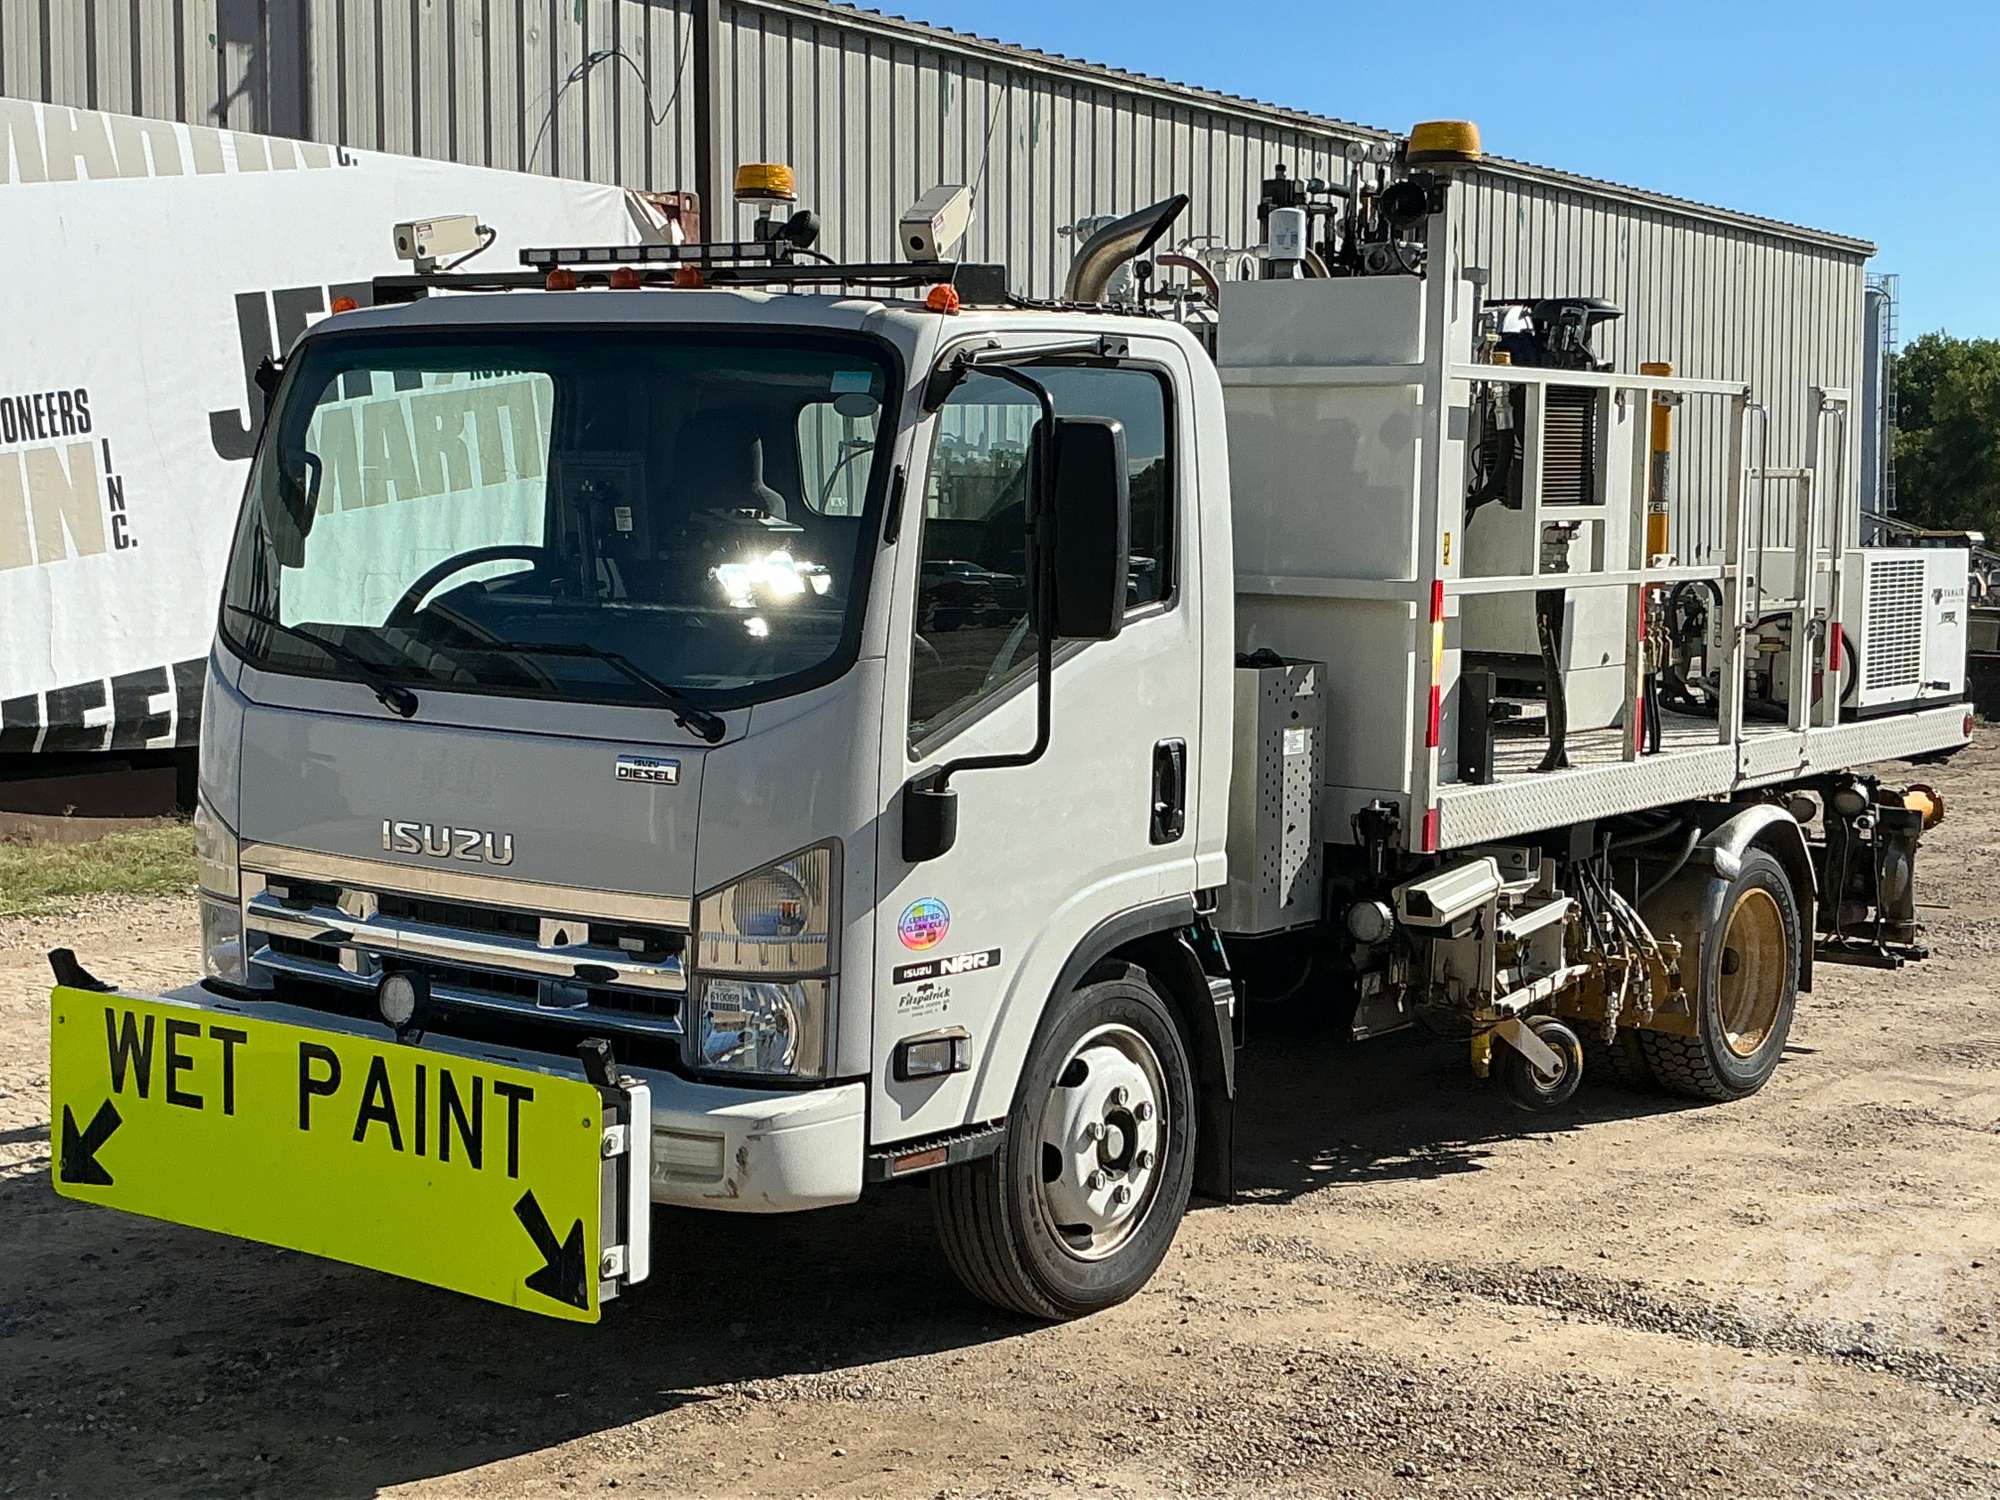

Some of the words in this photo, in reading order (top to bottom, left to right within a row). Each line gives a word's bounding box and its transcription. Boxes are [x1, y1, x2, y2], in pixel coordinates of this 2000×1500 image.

[0, 388, 92, 445] ONEERS
[618, 767, 674, 782] DIESEL
[382, 818, 514, 866] ISUZU
[903, 965, 932, 979] ISUZU
[940, 952, 990, 975] NRR
[104, 1007, 248, 1116] WET
[299, 1042, 534, 1179] PAINT
